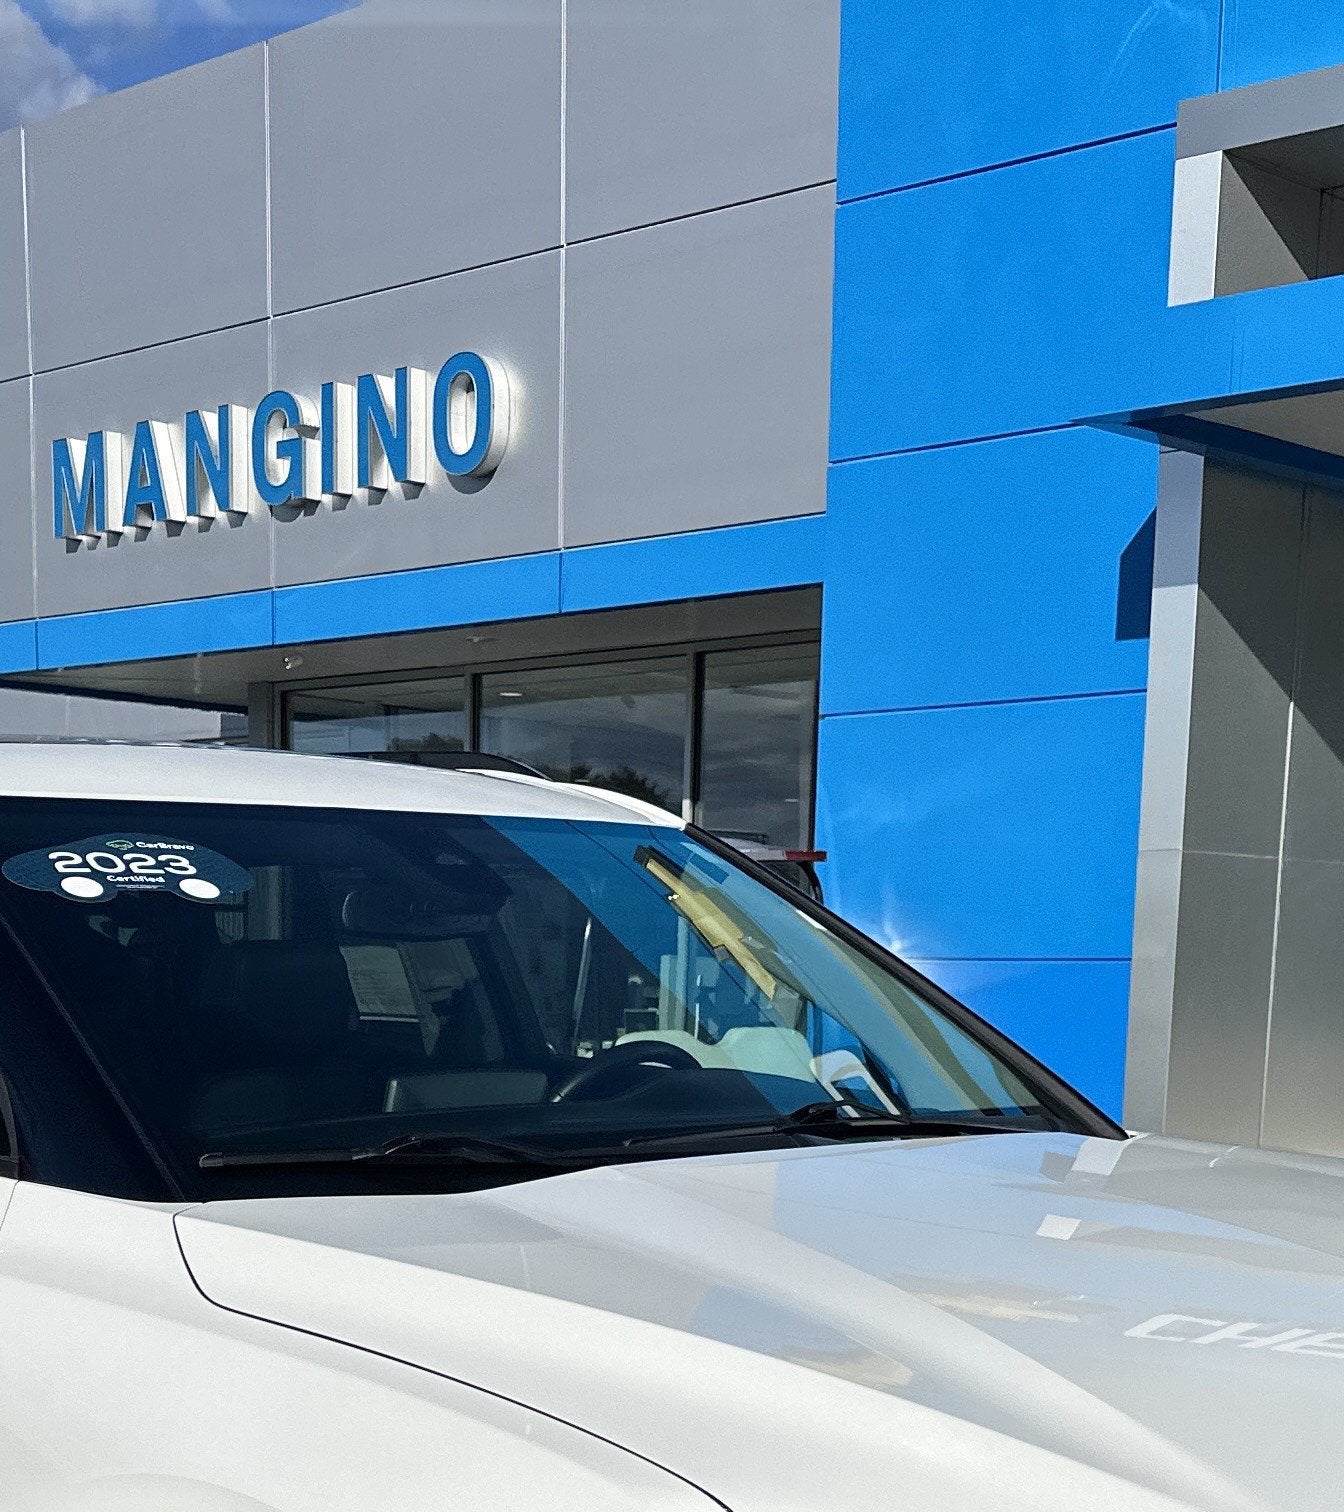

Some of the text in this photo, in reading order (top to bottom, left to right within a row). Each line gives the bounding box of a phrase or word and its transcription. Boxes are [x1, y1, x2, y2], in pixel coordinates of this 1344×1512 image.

[52, 350, 510, 540] MANGINO
[48, 851, 197, 875] 2023
[106, 875, 166, 883] Certified
